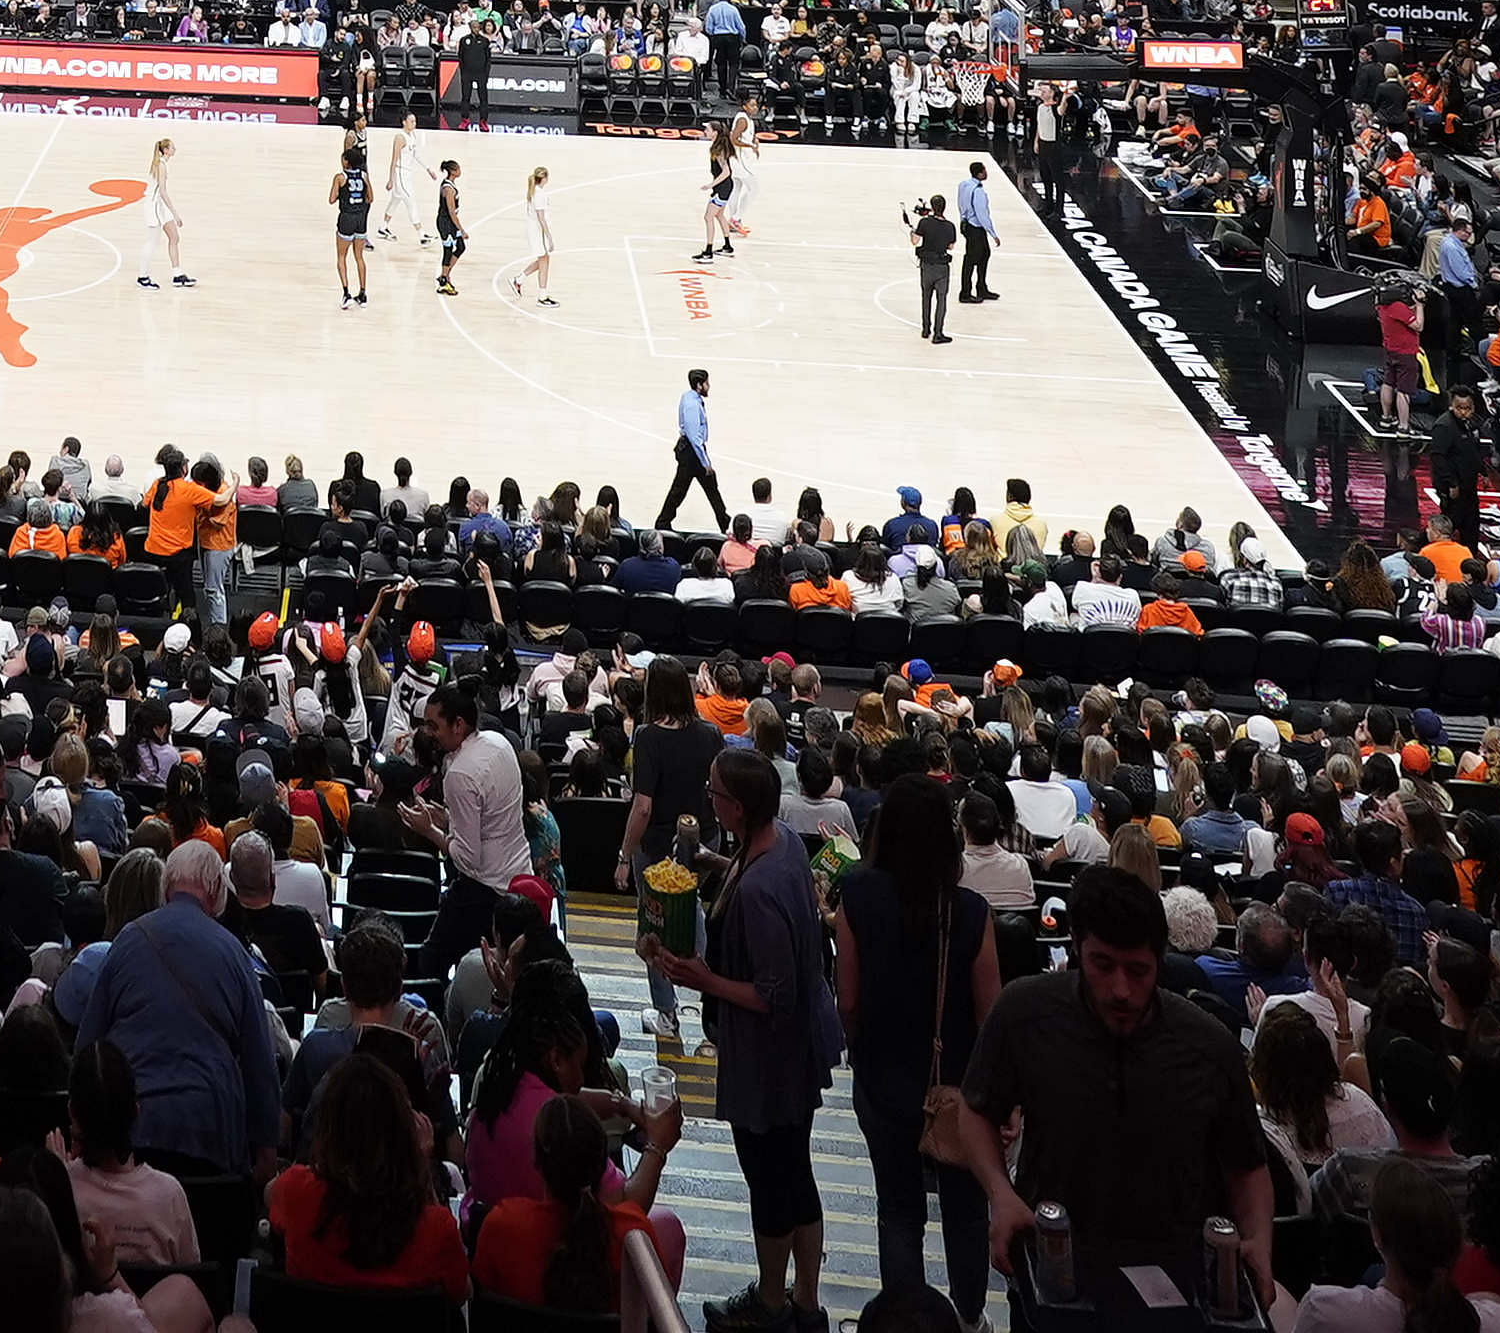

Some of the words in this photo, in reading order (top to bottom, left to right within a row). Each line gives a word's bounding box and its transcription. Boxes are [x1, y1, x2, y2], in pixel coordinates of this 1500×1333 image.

[136, 61, 184, 81] FOR
[190, 63, 278, 85] MORE
[1149, 44, 1237, 65] WNBA
[1292, 158, 1309, 207] WNBA
[679, 276, 711, 321] WNBA
[1072, 231, 1161, 310] CANADA
[1137, 311, 1218, 379] GAME
